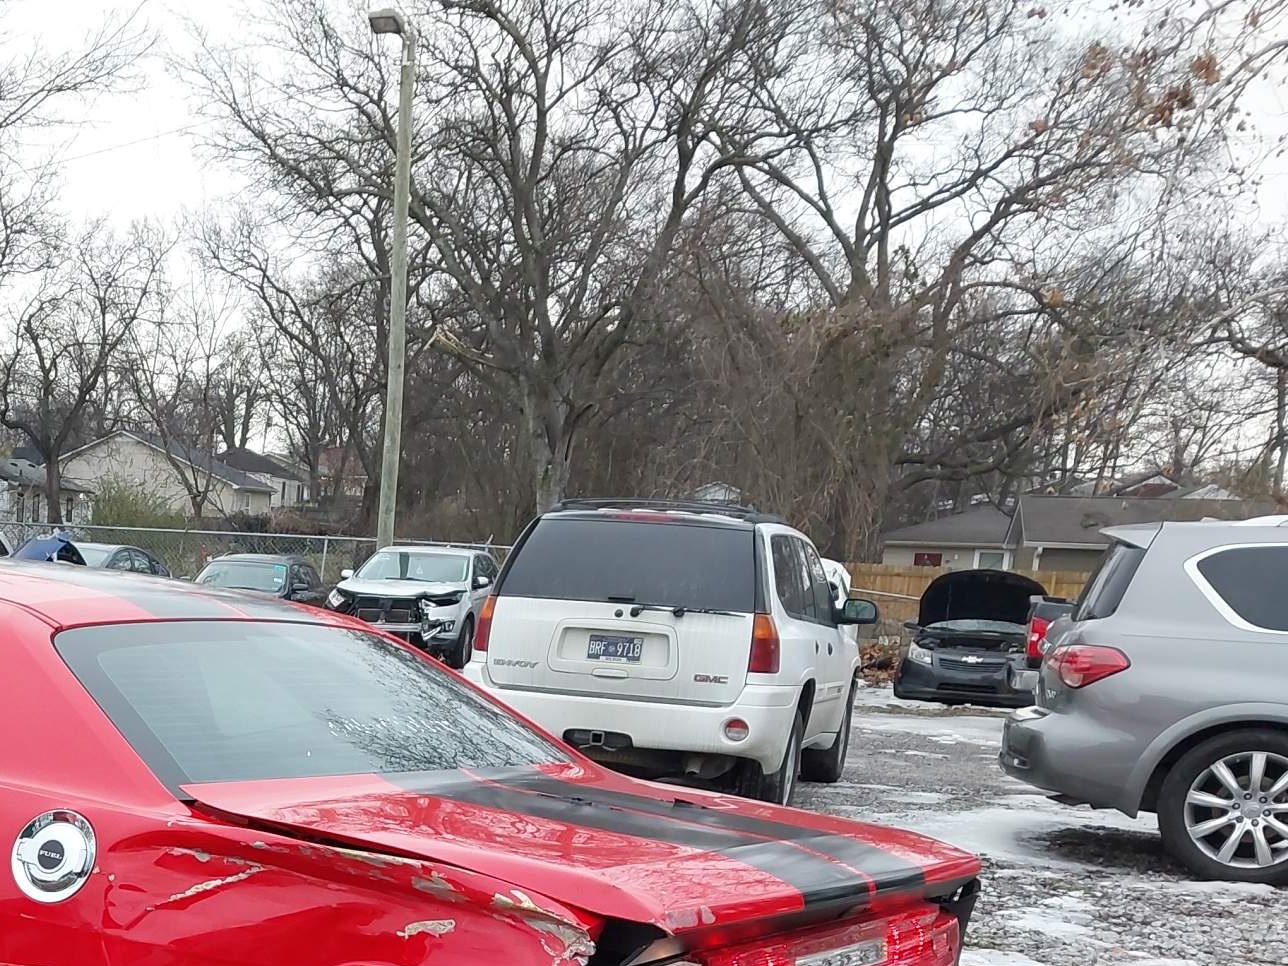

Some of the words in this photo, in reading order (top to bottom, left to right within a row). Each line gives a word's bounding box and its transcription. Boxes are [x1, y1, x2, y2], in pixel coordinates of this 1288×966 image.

[589, 640, 608, 655] BRF
[616, 642, 641, 657] 9718
[694, 674, 729, 684] GMC
